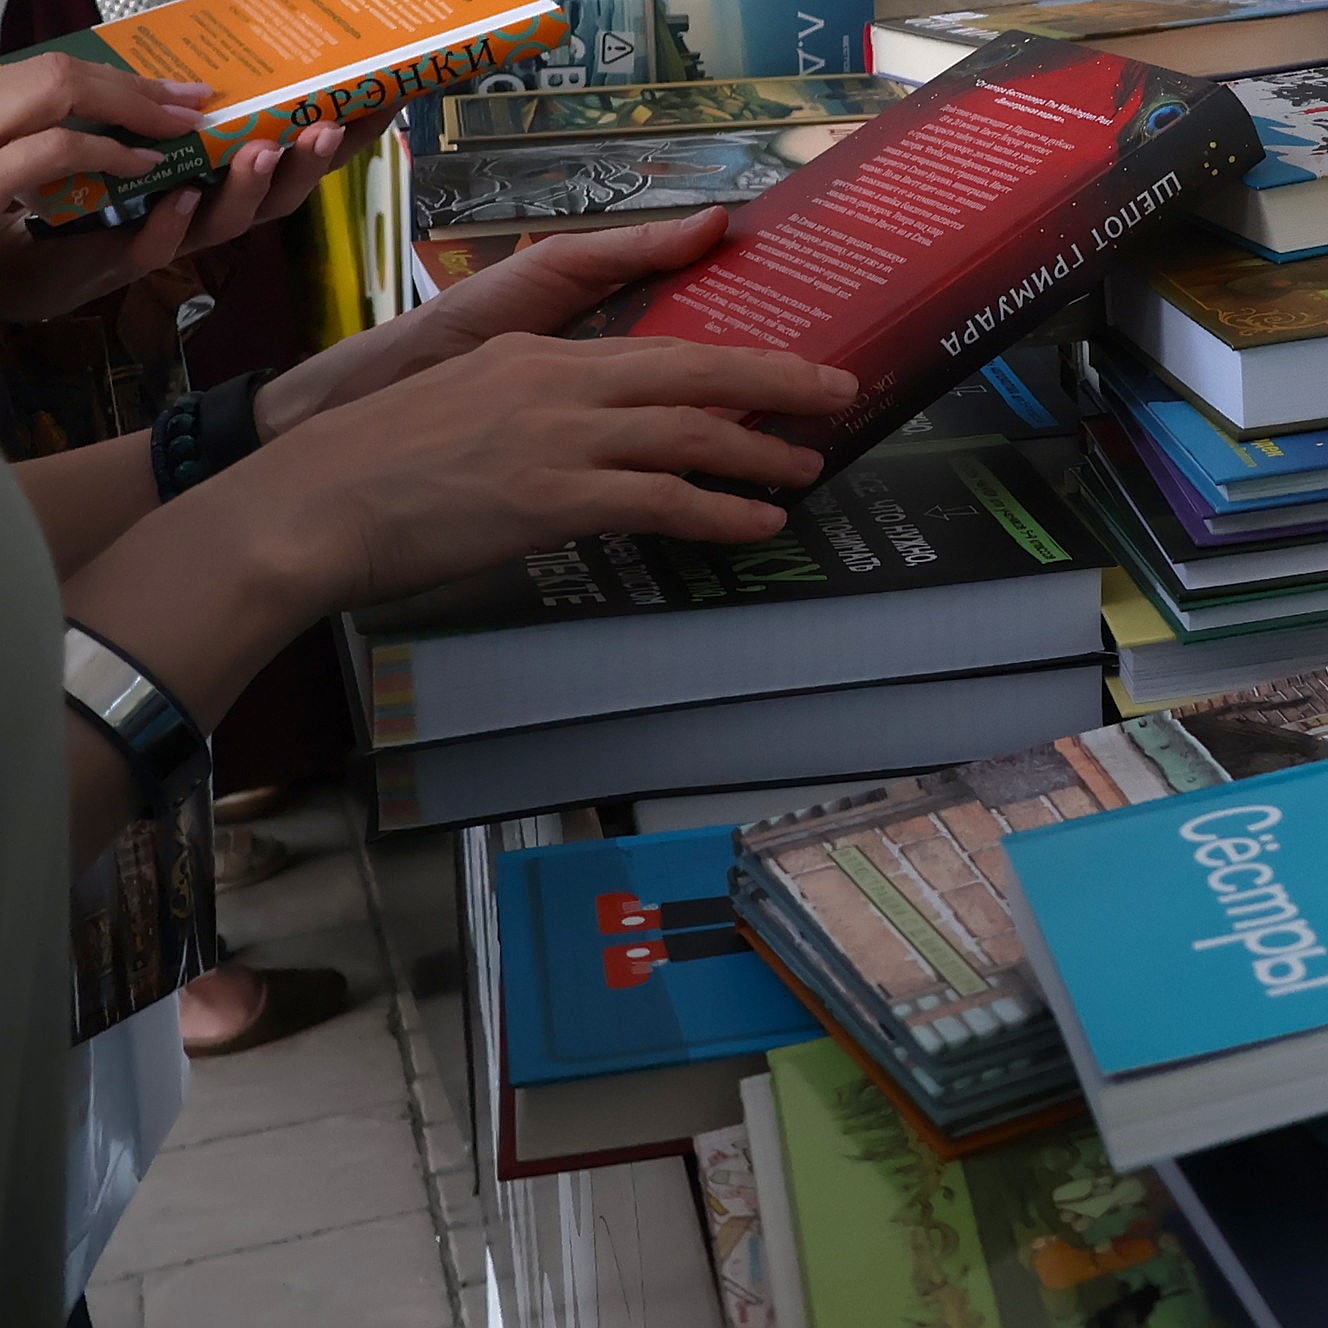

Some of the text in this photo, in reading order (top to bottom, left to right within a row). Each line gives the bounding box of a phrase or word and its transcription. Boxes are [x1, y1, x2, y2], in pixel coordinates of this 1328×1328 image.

[290, 37, 497, 131] ФРЭНКИ
[117, 167, 173, 193] МАКСИМ
[1092, 170, 1184, 255] ШЕПОТ
[939, 248, 1086, 359] ГРИМУАРА
